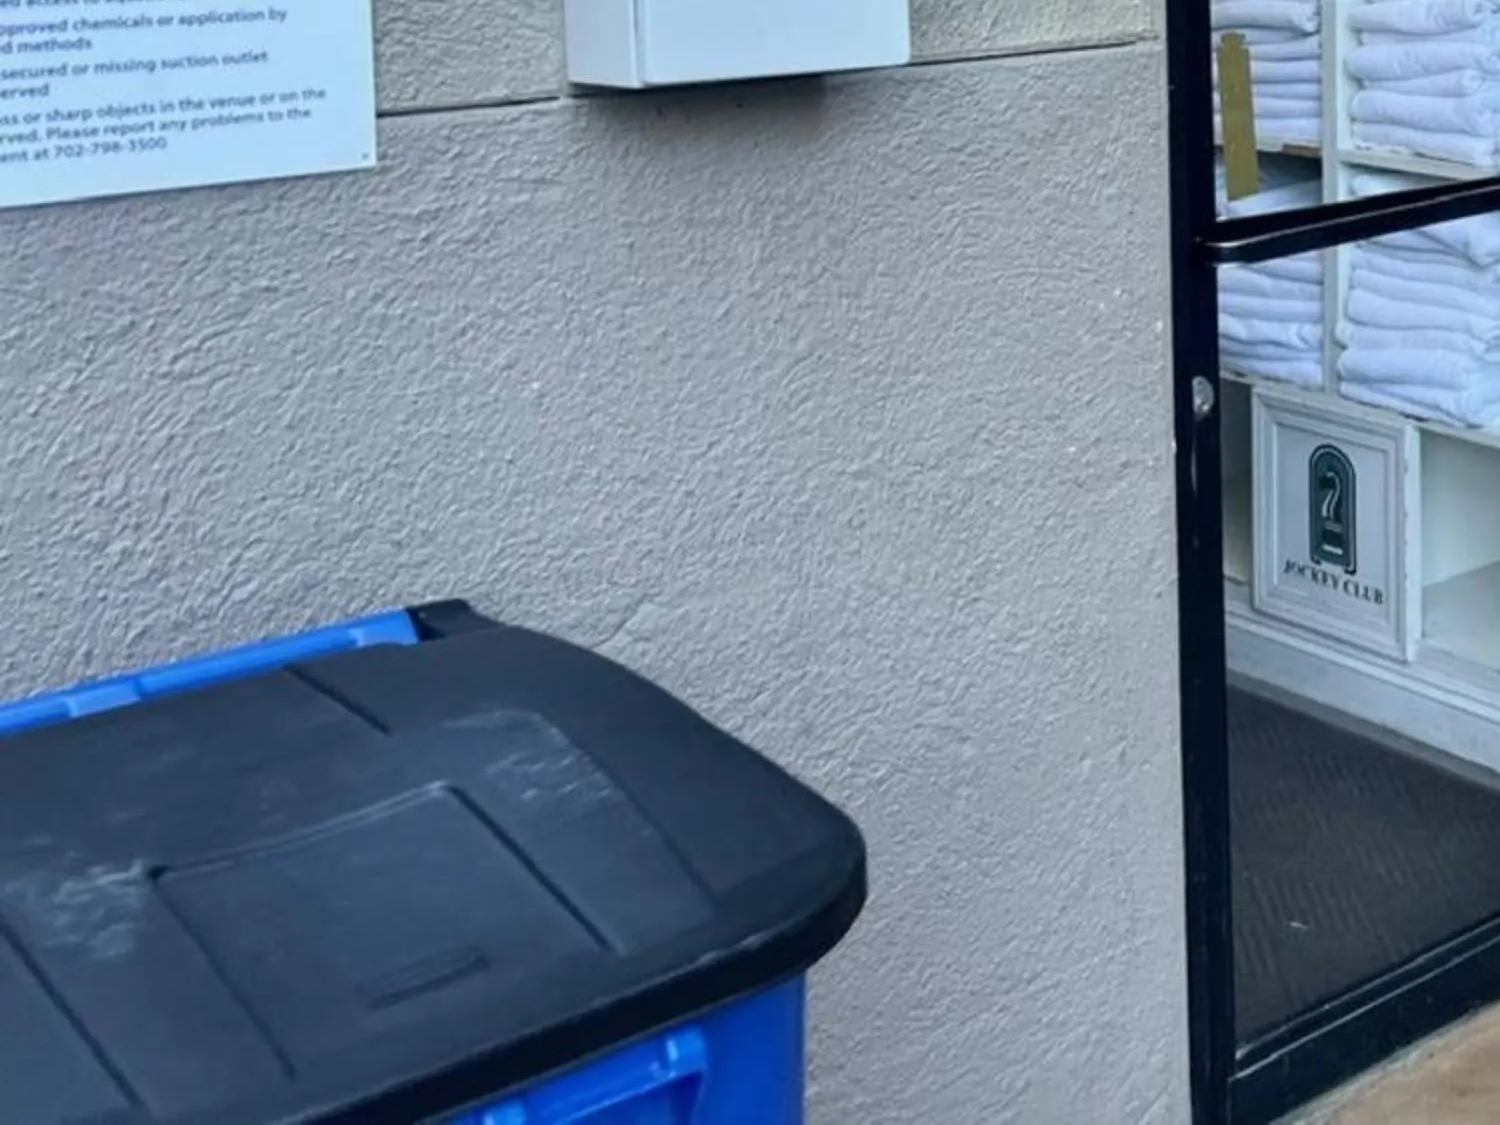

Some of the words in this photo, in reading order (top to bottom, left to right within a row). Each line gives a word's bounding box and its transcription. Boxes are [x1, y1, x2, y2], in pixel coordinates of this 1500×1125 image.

[72, 14, 152, 32] chemicals
[157, 16, 173, 27] or
[178, 10, 265, 27] application
[269, 7, 287, 23] by
[17, 37, 92, 53] methods
[72, 64, 89, 76] or
[94, 59, 156, 74] missing
[161, 55, 218, 70] suction
[222, 50, 268, 65] outlet
[23, 113, 41, 125] or
[46, 108, 92, 122] sharp
[96, 103, 155, 120] objects
[160, 100, 174, 113] in
[178, 97, 205, 112] the
[208, 95, 255, 109] venue
[260, 93, 275, 105] or
[279, 91, 299, 103] on
[303, 89, 326, 100] the
[46, 127, 99, 140] Please
[103, 118, 155, 139] report
[159, 120, 187, 132] any
[191, 113, 264, 131] problems
[268, 111, 284, 122] to
[288, 108, 311, 119] the
[33, 148, 49, 161] at
[1343, 581, 1385, 606] CLUB
